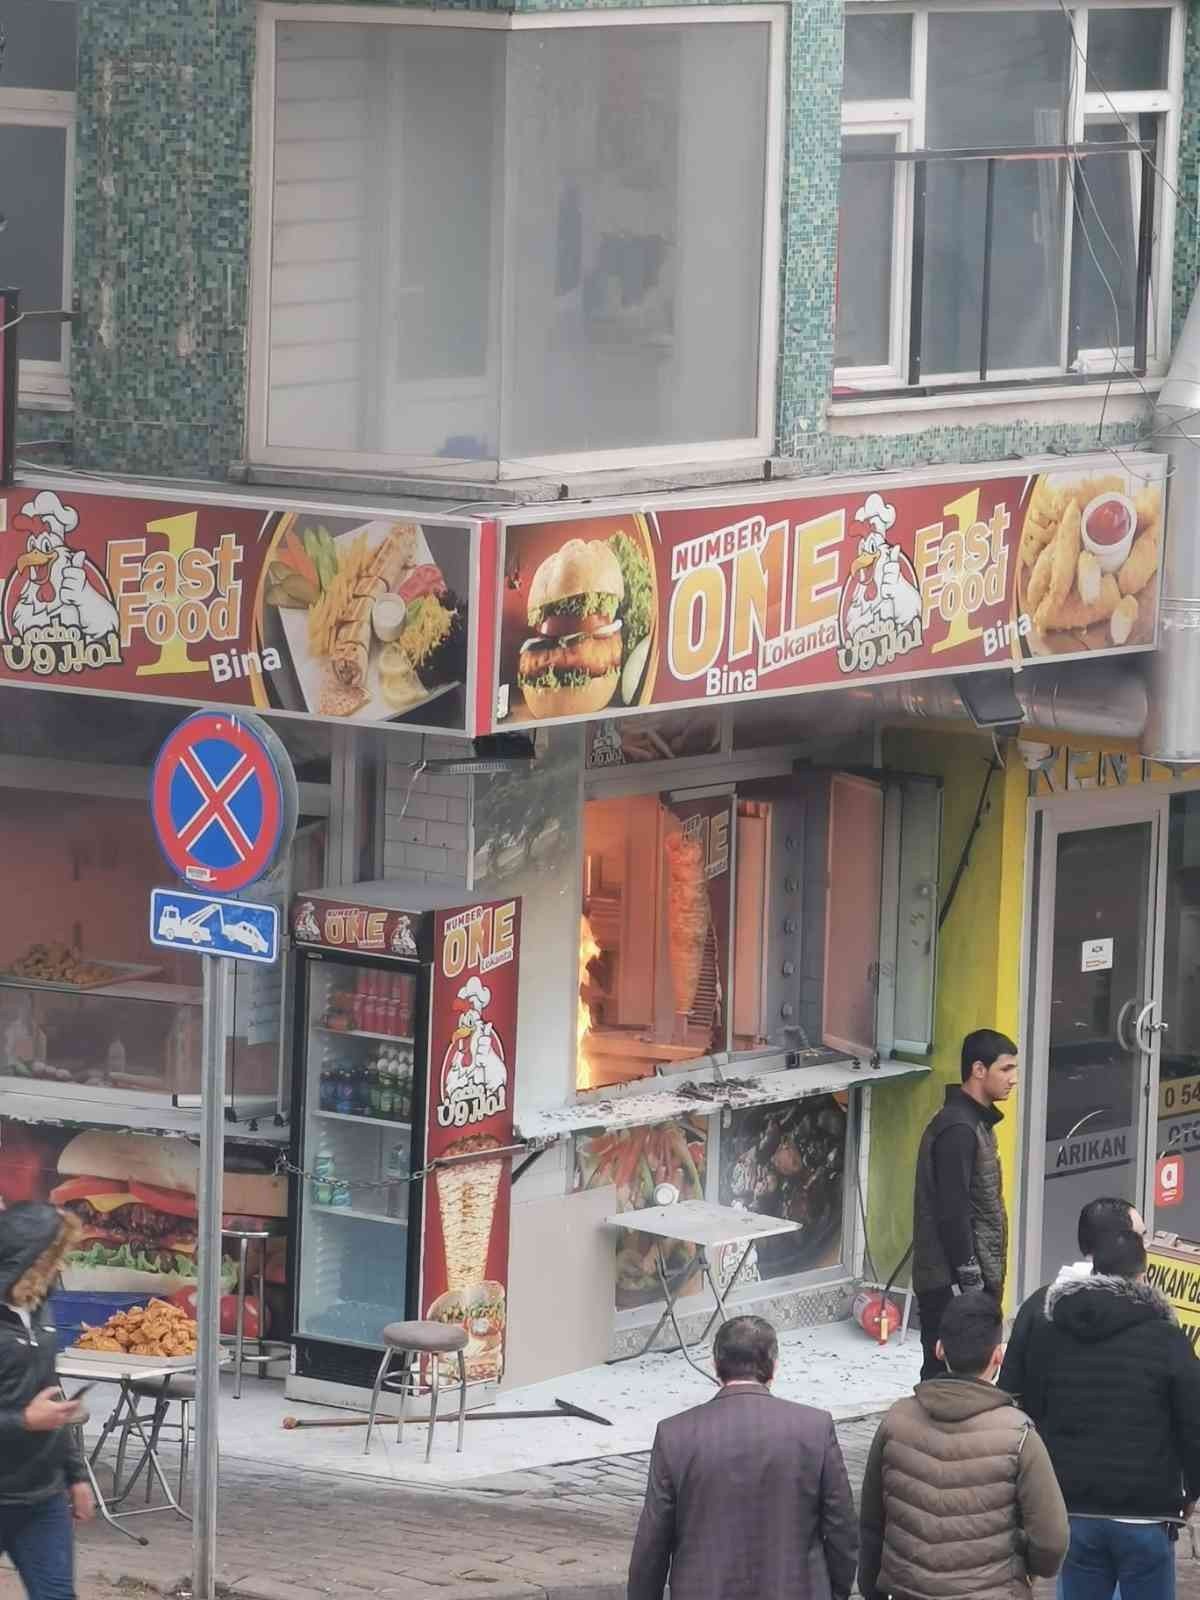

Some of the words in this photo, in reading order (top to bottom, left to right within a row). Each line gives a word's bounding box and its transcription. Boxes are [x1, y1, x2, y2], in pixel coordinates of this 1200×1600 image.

[675, 521, 764, 574] NUMBER
[914, 502, 1011, 576] Fast
[106, 532, 243, 604] Fast
[921, 550, 1008, 630] Food
[118, 583, 242, 648] Food
[667, 508, 847, 681] ONE
[761, 622, 838, 670] Lokanta
[983, 614, 1031, 656] Bina
[209, 643, 282, 684] Bina
[706, 664, 758, 697] Bina
[325, 911, 388, 945] ONE
[443, 901, 516, 978] ONE
[1165, 1087, 1175, 1108] 0
[1056, 1135, 1126, 1168] ARIKAN
